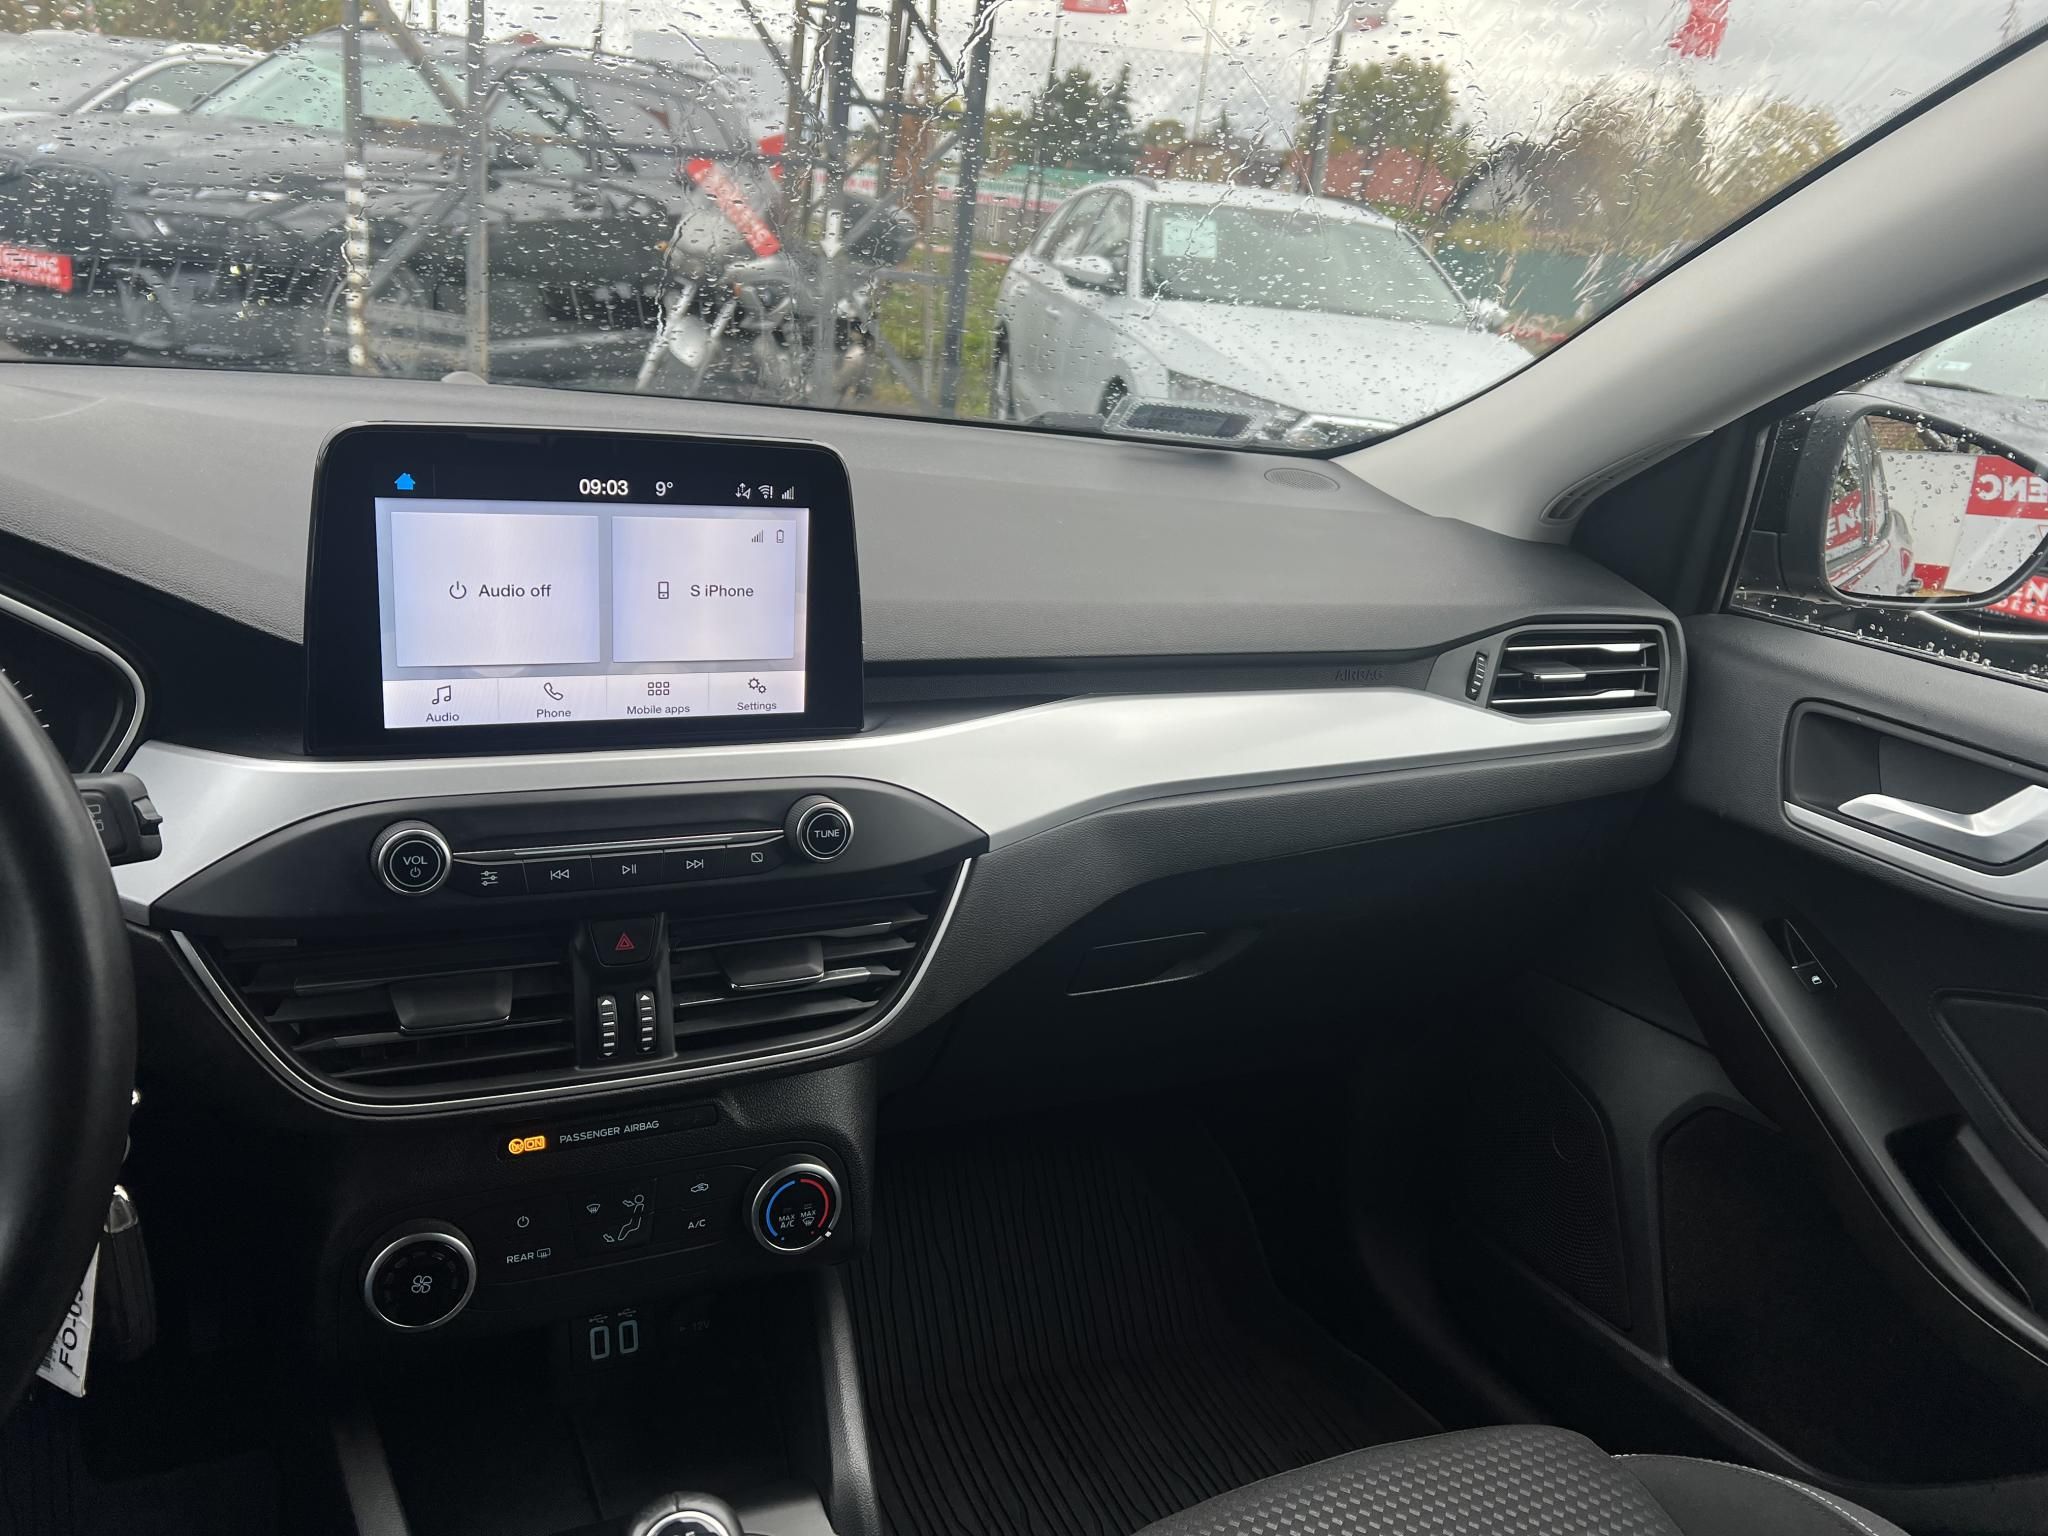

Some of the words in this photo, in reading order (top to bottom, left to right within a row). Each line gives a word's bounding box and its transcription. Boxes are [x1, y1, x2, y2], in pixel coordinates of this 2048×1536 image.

[579, 478, 629, 496] 09:03
[655, 481, 674, 497] 9°
[478, 583, 526, 598] Audio
[530, 583, 552, 598] off
[690, 584, 701, 598] S
[704, 583, 755, 598] iPhone
[1335, 667, 1385, 681] AIRBAG
[626, 705, 662, 716] Mobile
[664, 705, 691, 717] apps
[736, 701, 777, 712] Settings
[425, 713, 460, 723] Audio
[536, 709, 572, 719] Phone
[814, 829, 840, 838] TUNE
[402, 855, 428, 866] VOL
[559, 1126, 621, 1144] PASSENGER
[623, 1120, 660, 1134] AIRBAG
[778, 1214, 796, 1222] MAX
[800, 1209, 817, 1218] MAX
[687, 1219, 706, 1230] A/C
[780, 1220, 795, 1229] A/C
[506, 1251, 535, 1264] REAR
